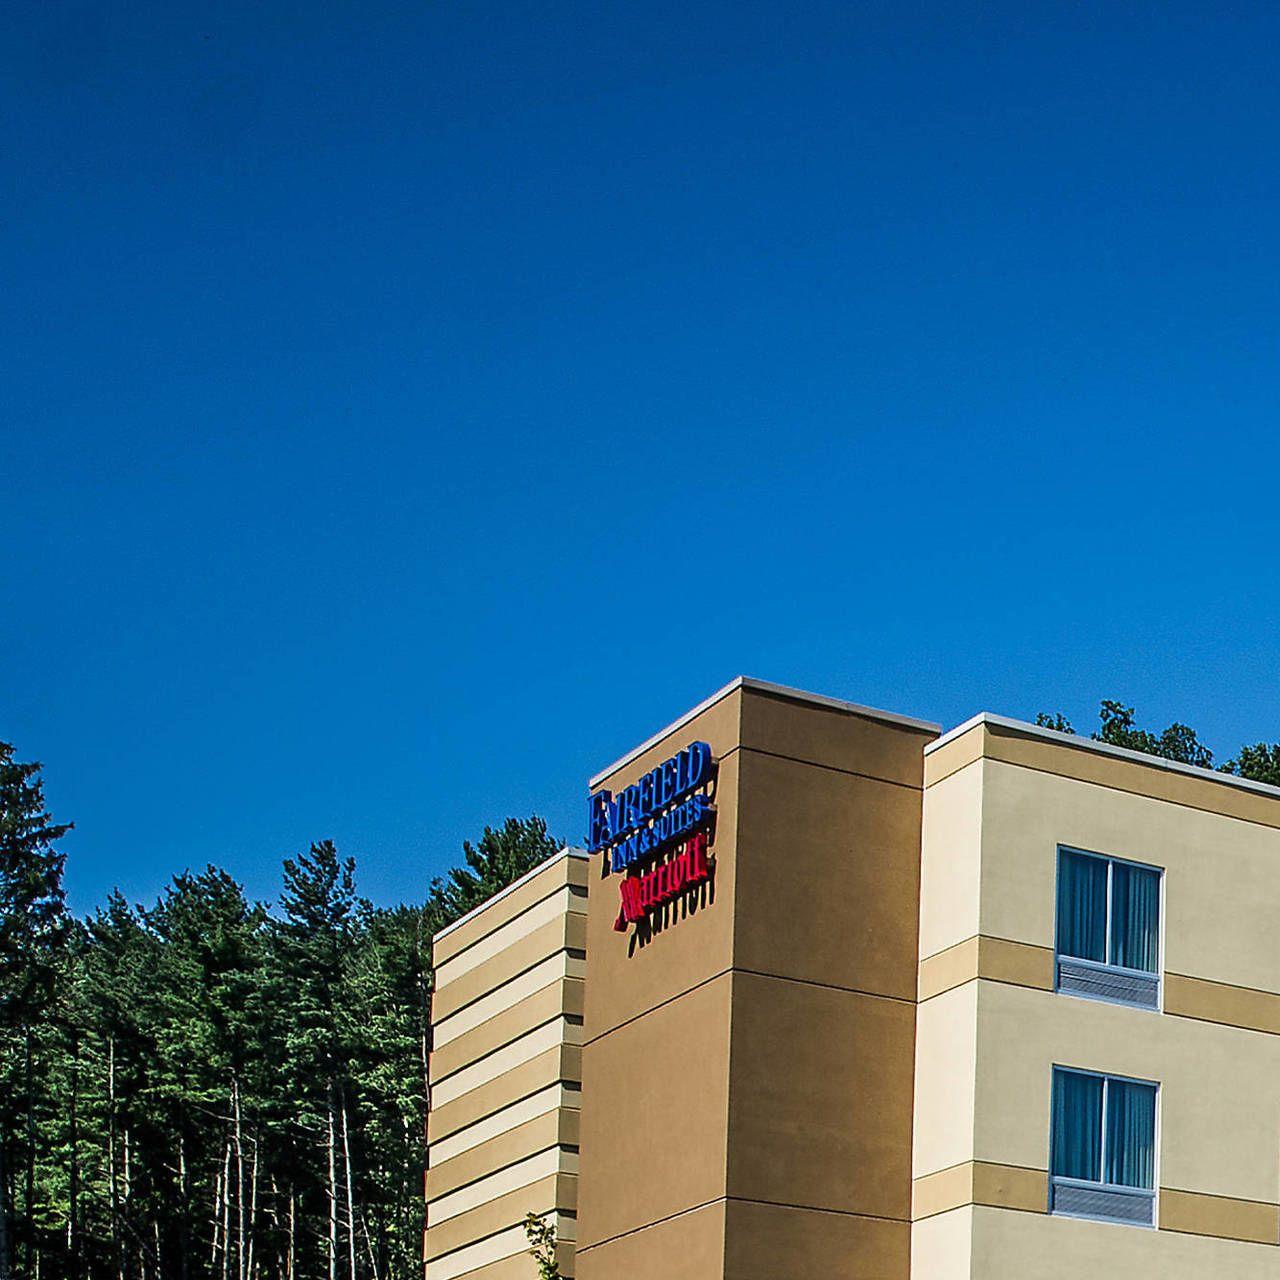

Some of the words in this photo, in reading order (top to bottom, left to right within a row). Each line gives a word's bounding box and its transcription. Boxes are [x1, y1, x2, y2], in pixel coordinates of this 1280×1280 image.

[587, 741, 712, 854] FAIRFIELD
[611, 835, 638, 873] INN
[651, 795, 707, 847] SUITES
[614, 833, 708, 933] Marriott
